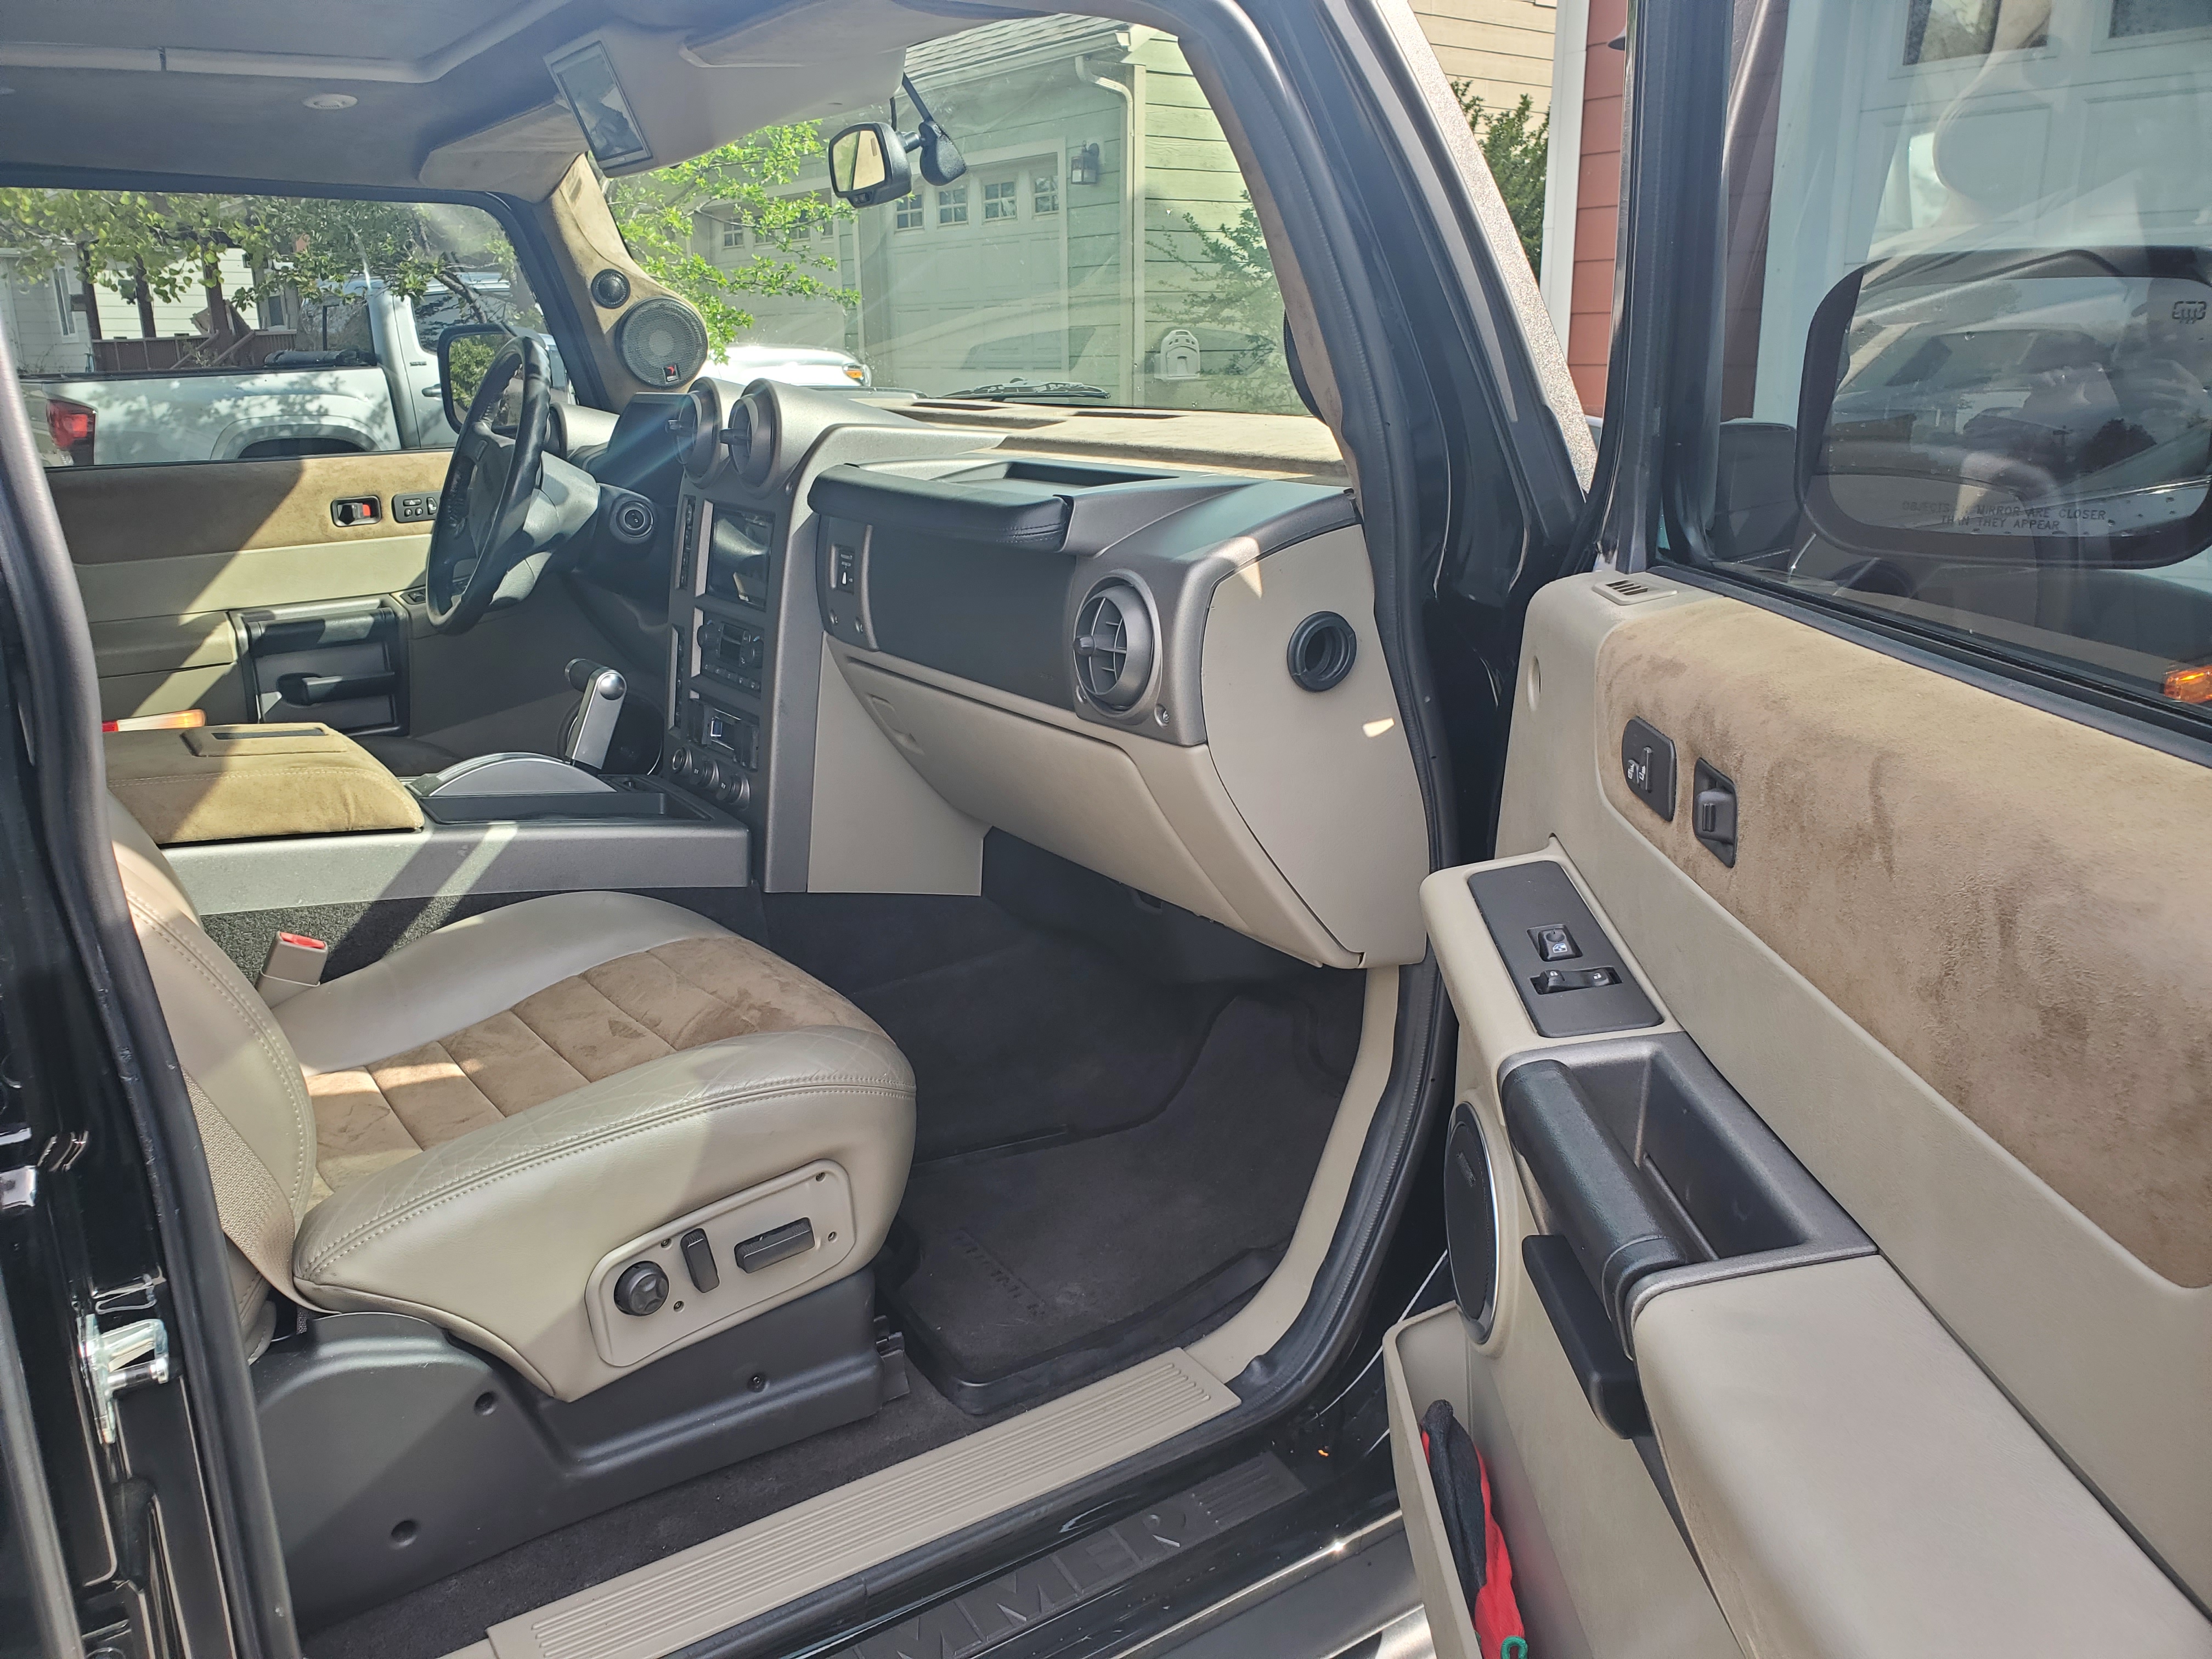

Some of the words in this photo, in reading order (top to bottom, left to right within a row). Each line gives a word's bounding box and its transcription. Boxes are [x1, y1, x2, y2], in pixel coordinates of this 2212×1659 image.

[1977, 505, 2020, 515] MIRROR
[2027, 508, 2050, 517] ARE
[2059, 509, 2106, 520] CLOSER
[1978, 518, 2006, 528] THEY
[2013, 520, 2060, 530] APPEAR
